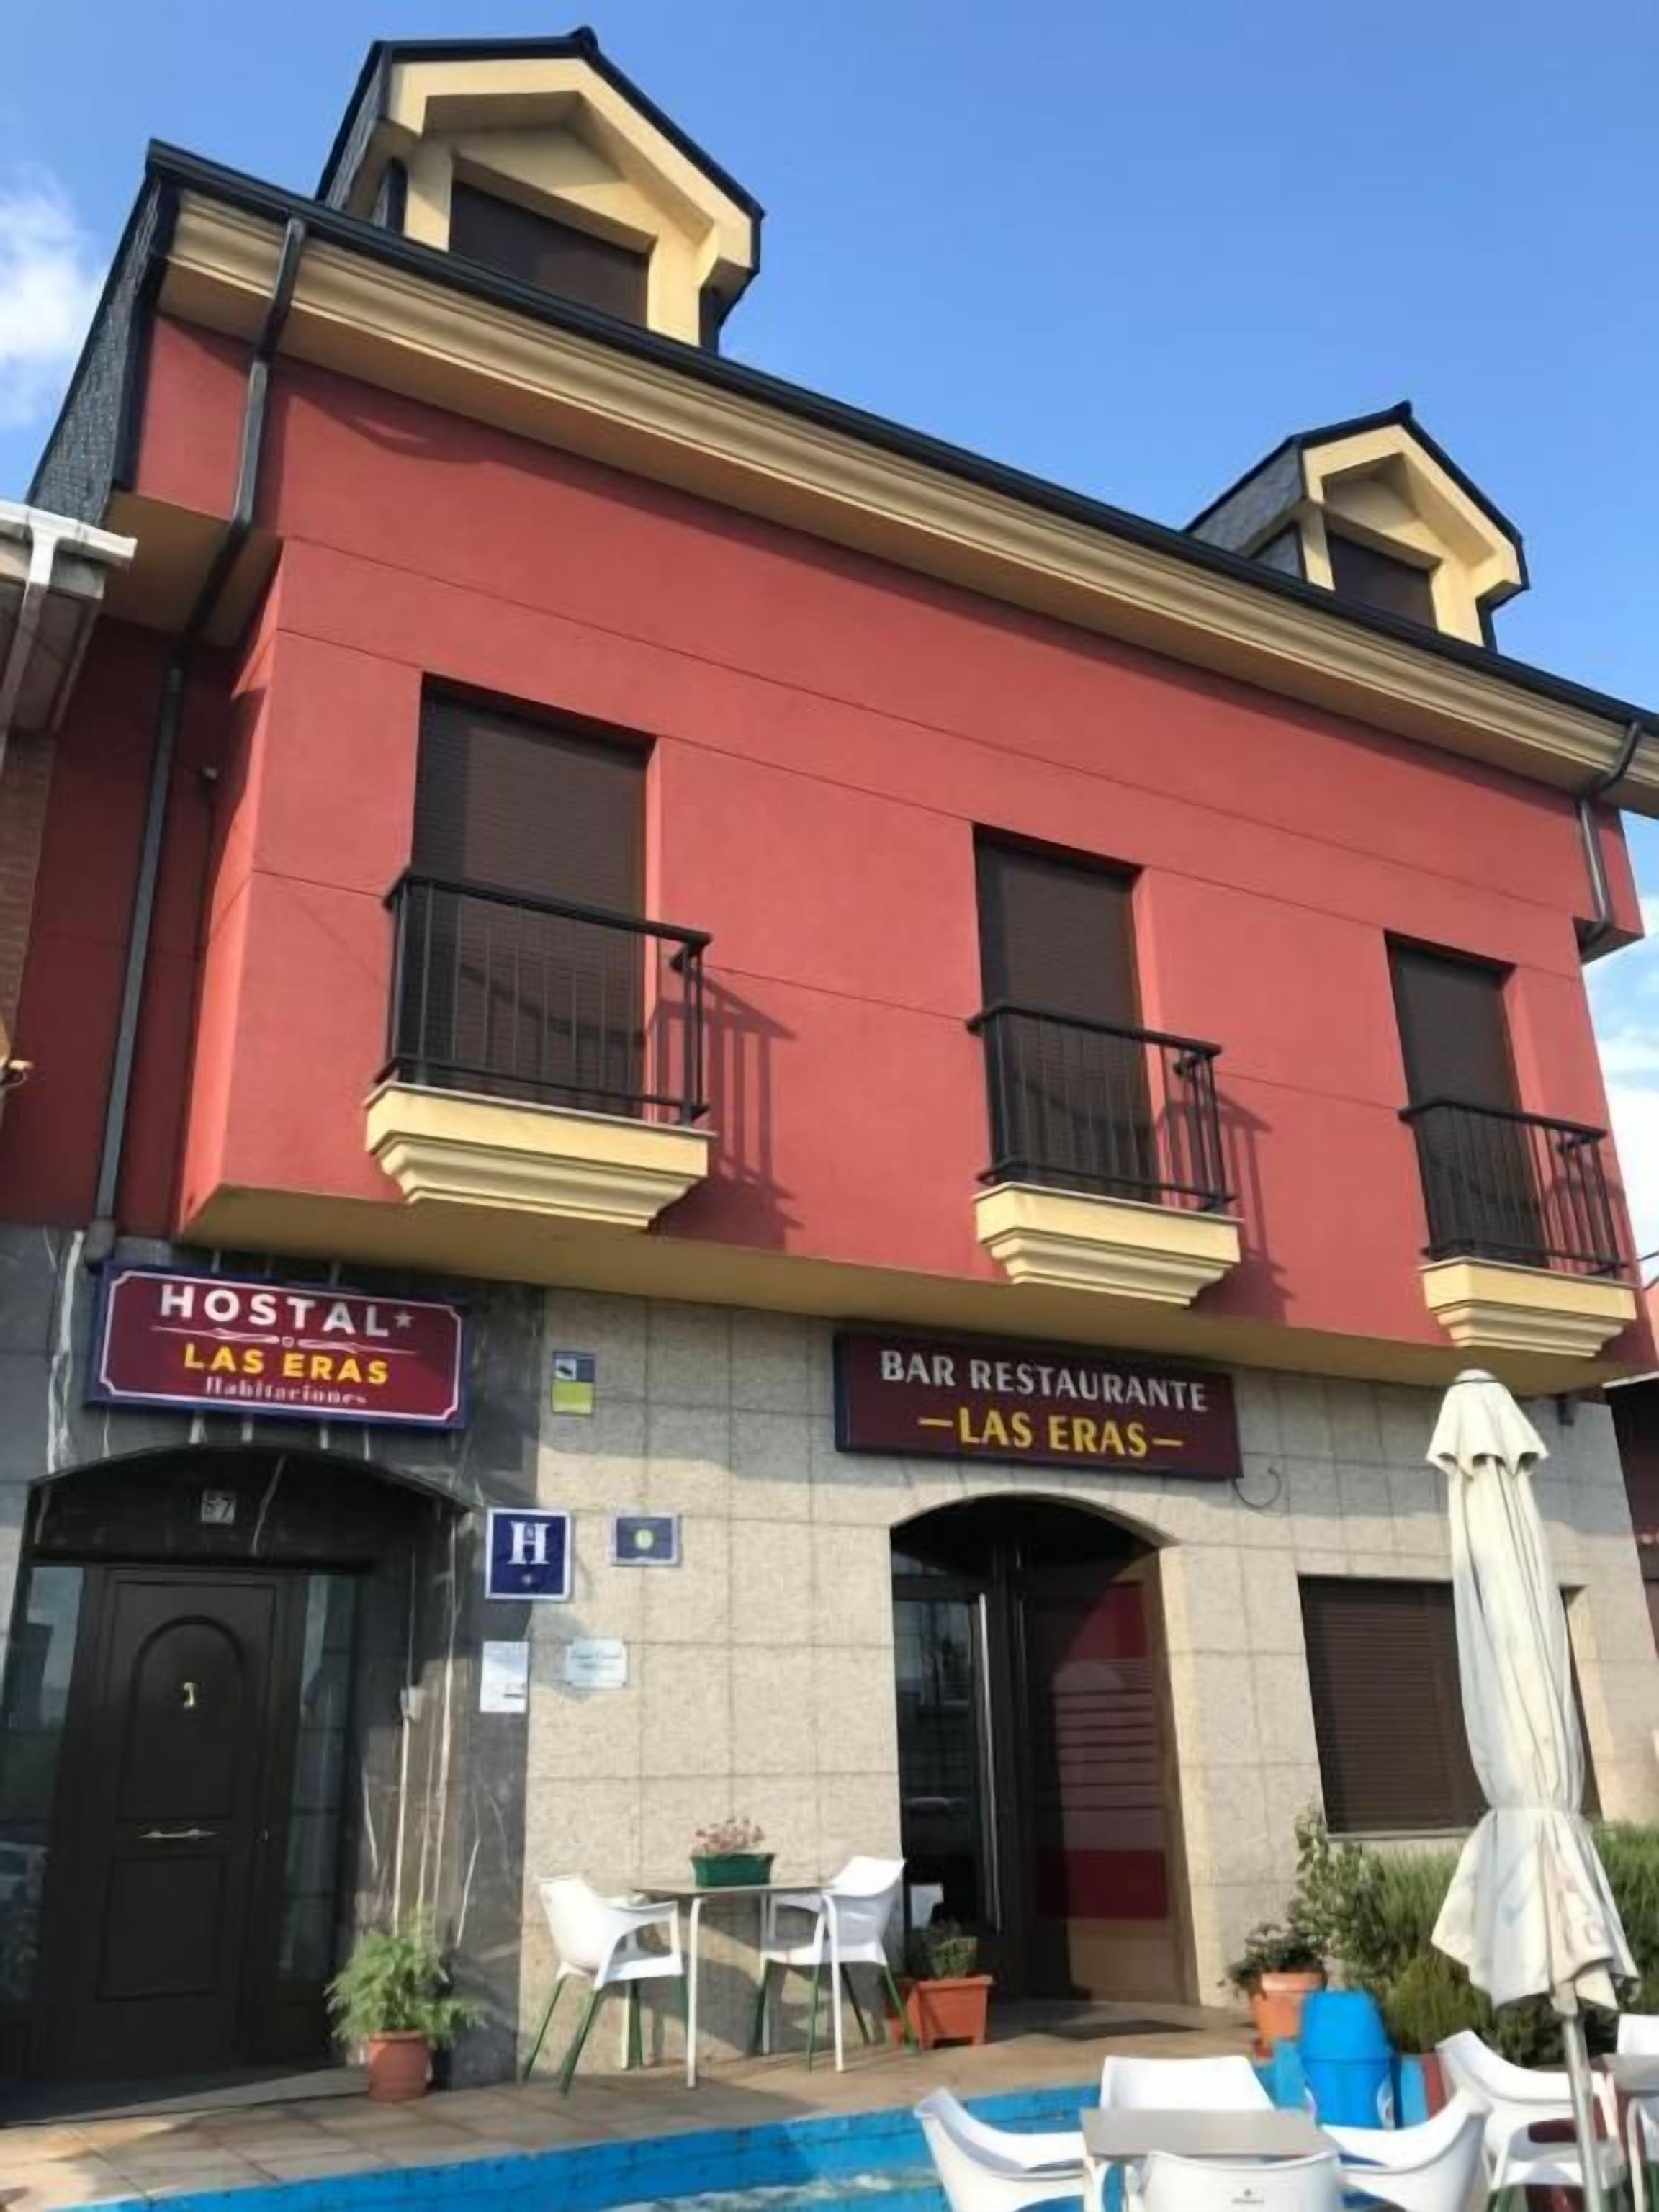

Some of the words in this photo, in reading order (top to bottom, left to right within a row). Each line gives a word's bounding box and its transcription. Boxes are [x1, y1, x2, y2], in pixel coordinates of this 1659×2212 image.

[160, 1284, 390, 1337] HOSTAL
[184, 1342, 264, 1375] LAS
[283, 1353, 390, 1385] ERAS
[880, 1349, 956, 1387] BAR
[969, 1359, 1209, 1411] RESTAURANTE
[958, 1407, 1032, 1449] LAS
[1048, 1415, 1148, 1458] ERAS
